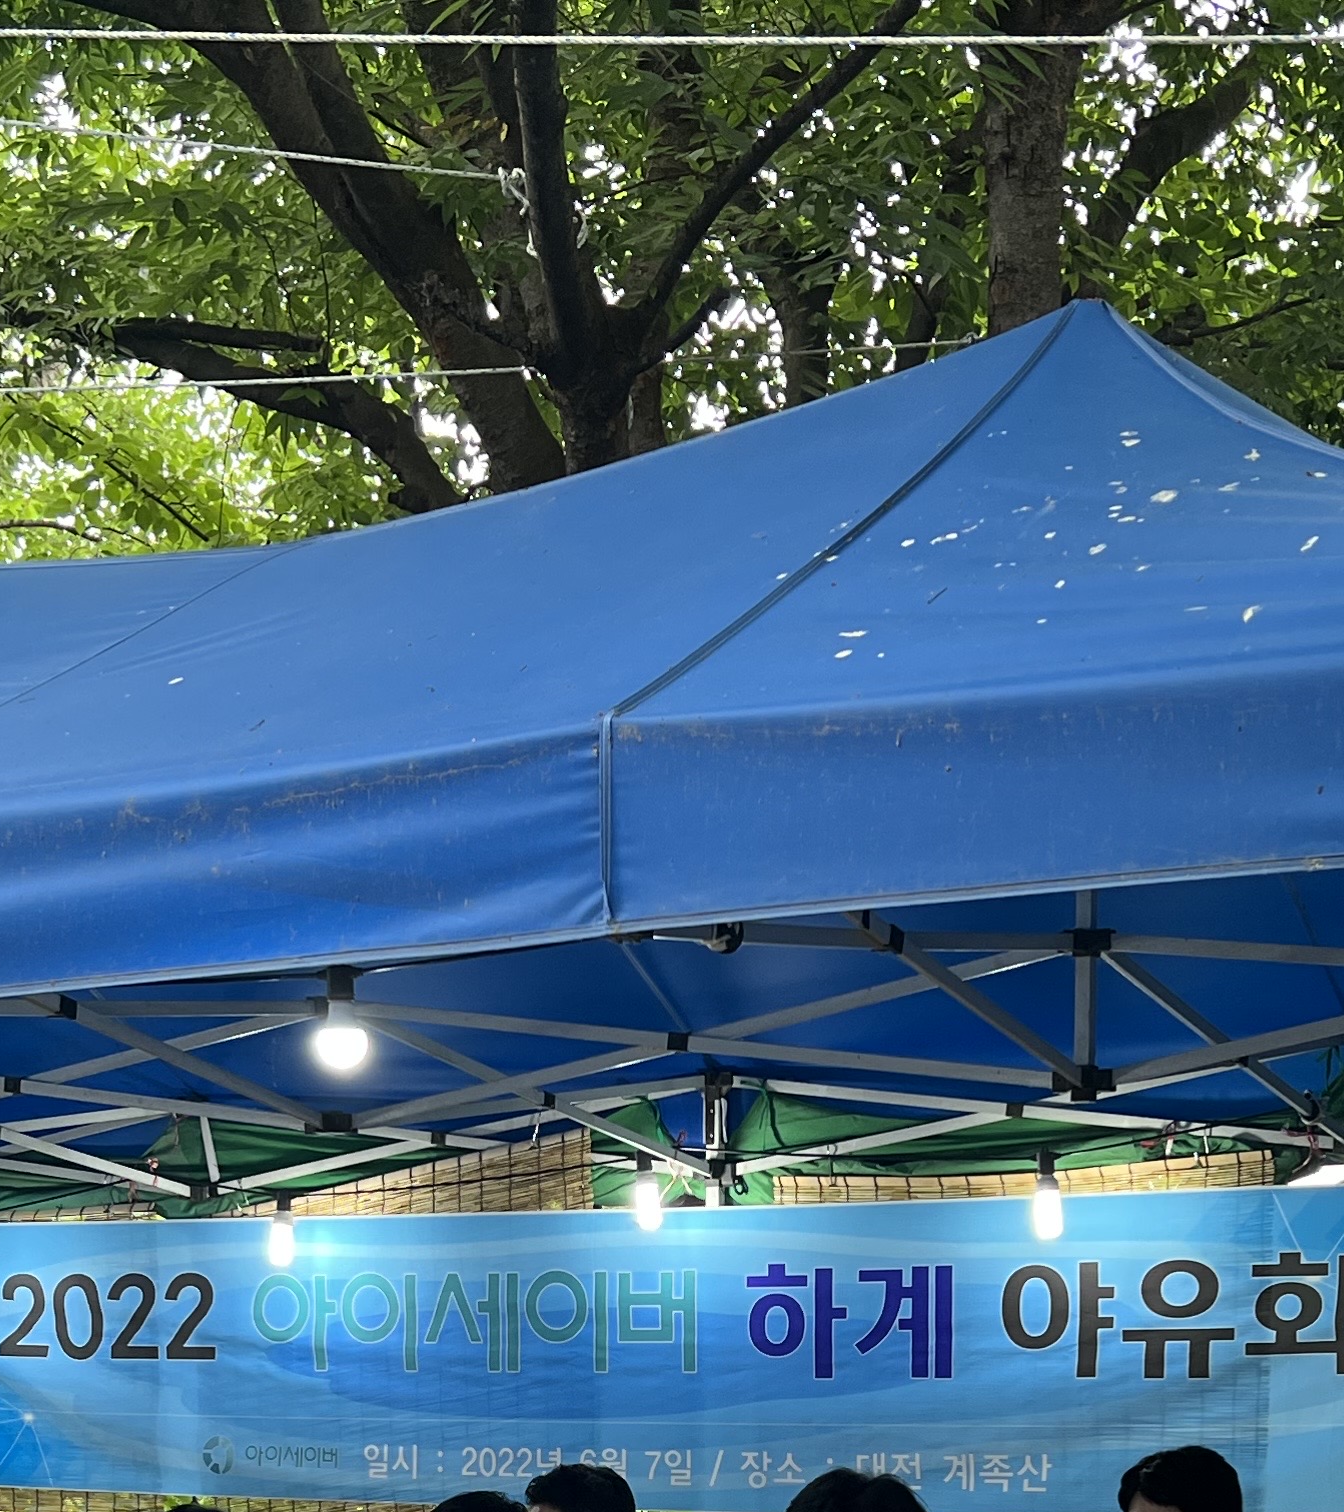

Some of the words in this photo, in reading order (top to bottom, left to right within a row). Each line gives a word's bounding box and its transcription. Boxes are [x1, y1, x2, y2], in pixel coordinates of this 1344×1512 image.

[254, 1269, 697, 1375] 아이세이버
[745, 1261, 955, 1380] 하계
[244, 1444, 338, 1469] 아이세이버
[363, 1444, 418, 1480] 일시
[461, 1446, 562, 1477] 2022년
[644, 1449, 692, 1486] 7일
[708, 1449, 724, 1487] /
[740, 1451, 806, 1489] 장소
[943, 1453, 1053, 1493] 계족산
